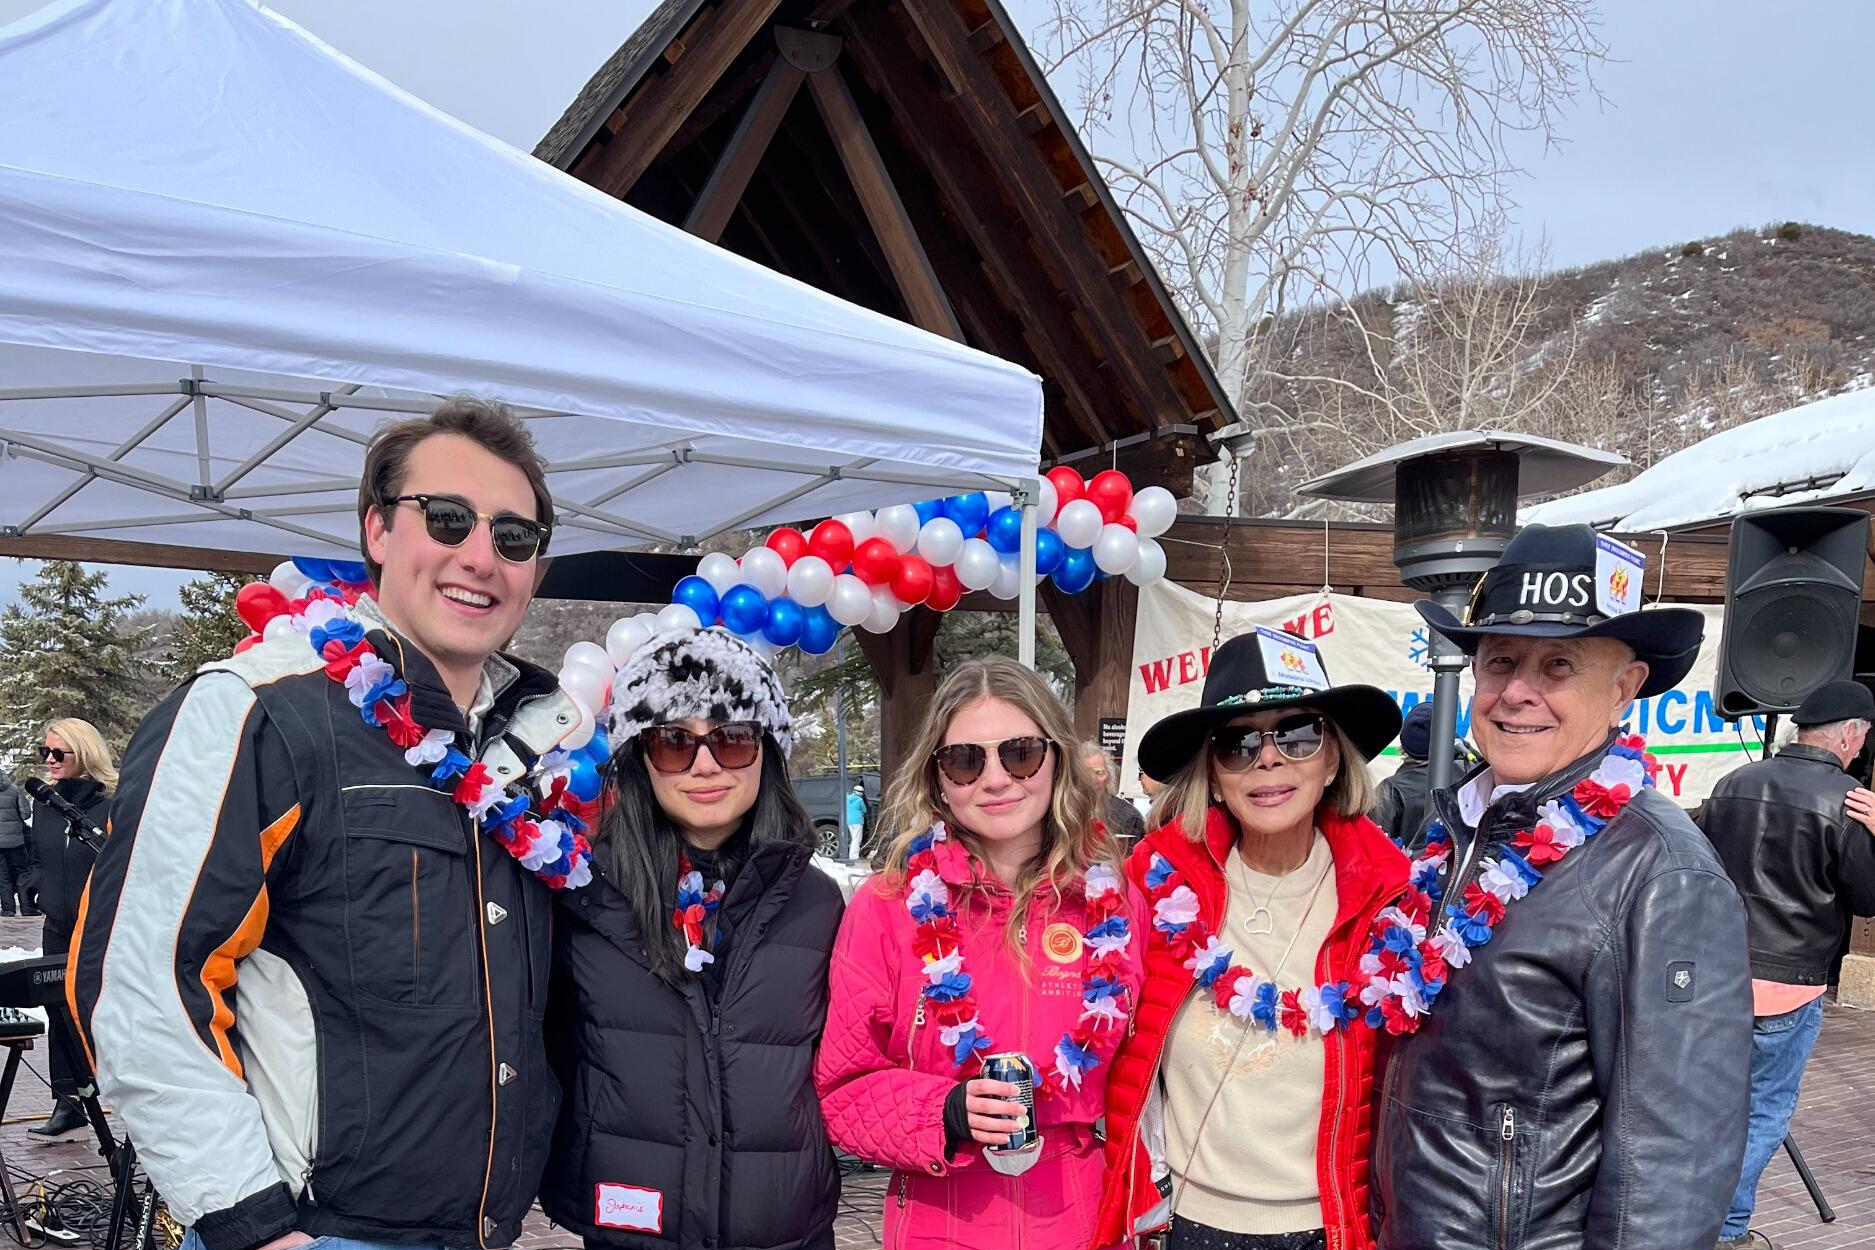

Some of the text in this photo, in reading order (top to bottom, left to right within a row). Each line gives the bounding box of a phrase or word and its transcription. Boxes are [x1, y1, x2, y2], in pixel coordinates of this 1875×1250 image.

[1520, 572, 1597, 607] HOS
[42, 968, 67, 983] YAMAH
[1041, 989, 1082, 998] AMBITIO
